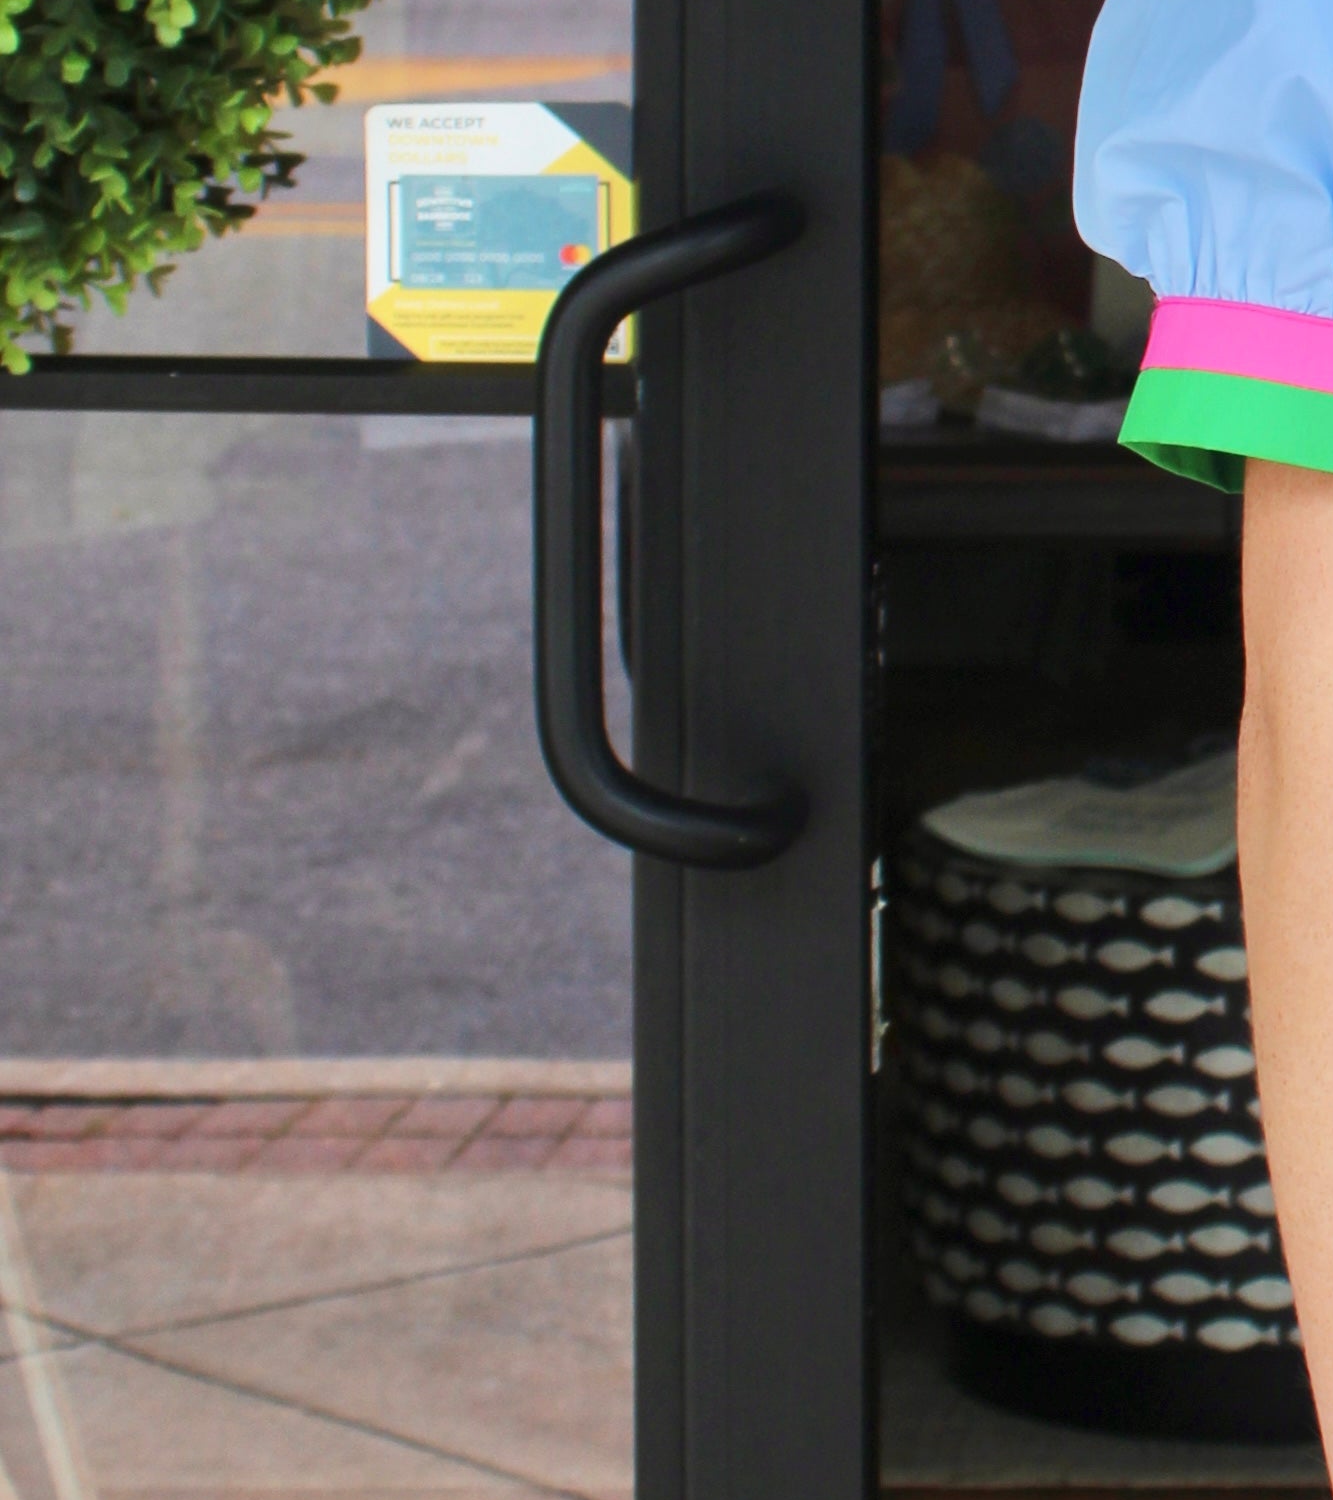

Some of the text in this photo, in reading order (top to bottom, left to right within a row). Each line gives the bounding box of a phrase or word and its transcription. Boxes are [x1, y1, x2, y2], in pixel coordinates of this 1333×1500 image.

[388, 117, 485, 130] WE ACCEPT
[388, 134, 499, 147] DOWNTOWN
